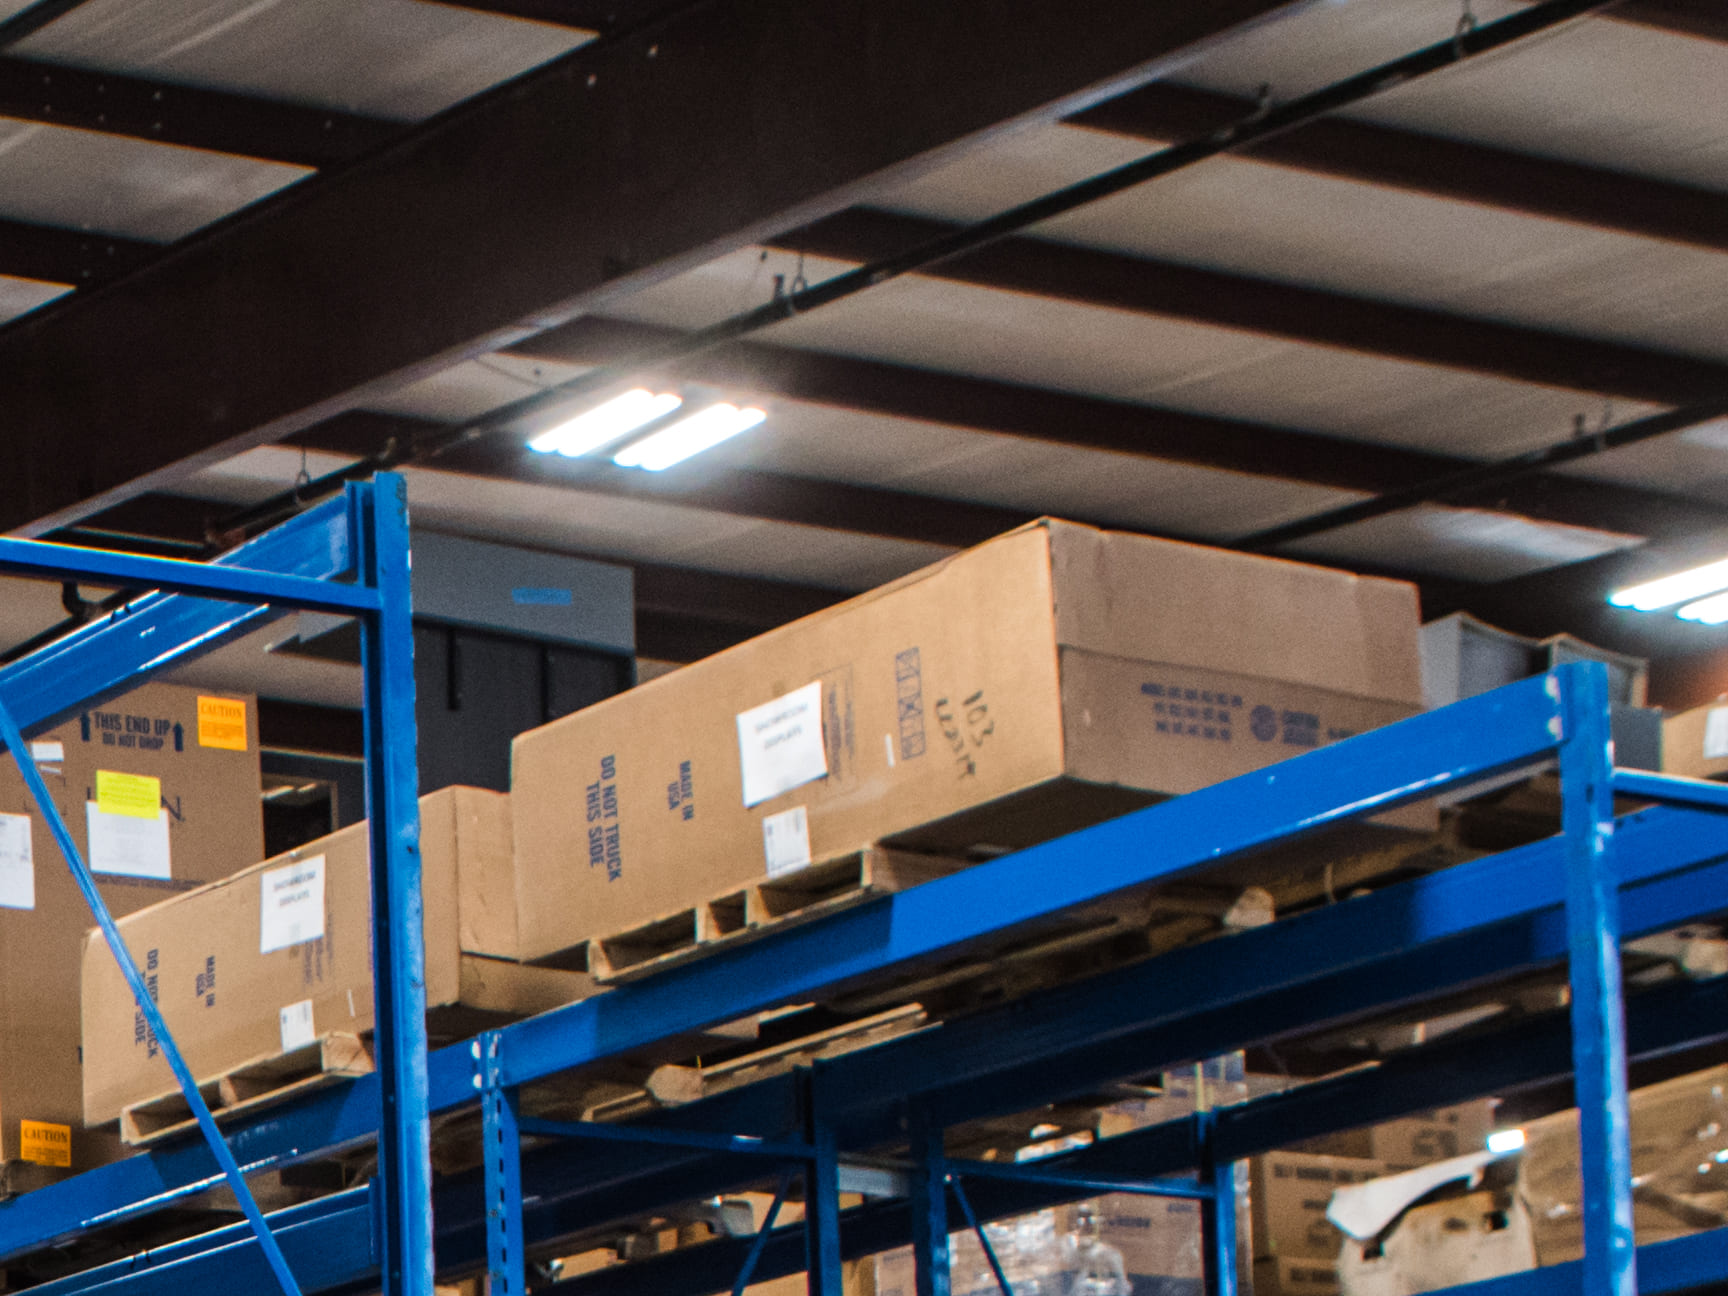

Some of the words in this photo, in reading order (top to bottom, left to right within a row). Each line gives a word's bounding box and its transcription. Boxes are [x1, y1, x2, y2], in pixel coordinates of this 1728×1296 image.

[94, 711, 122, 730] THIS
[125, 714, 151, 734] END
[154, 718, 172, 736] UP
[117, 734, 137, 748] NOT
[600, 754, 616, 780] DO
[586, 780, 602, 822] THIS
[602, 784, 618, 818] NOT
[588, 826, 604, 868] SIDE
[604, 823, 622, 882] TRUCK
[23, 1127, 69, 1144] CAUTION
